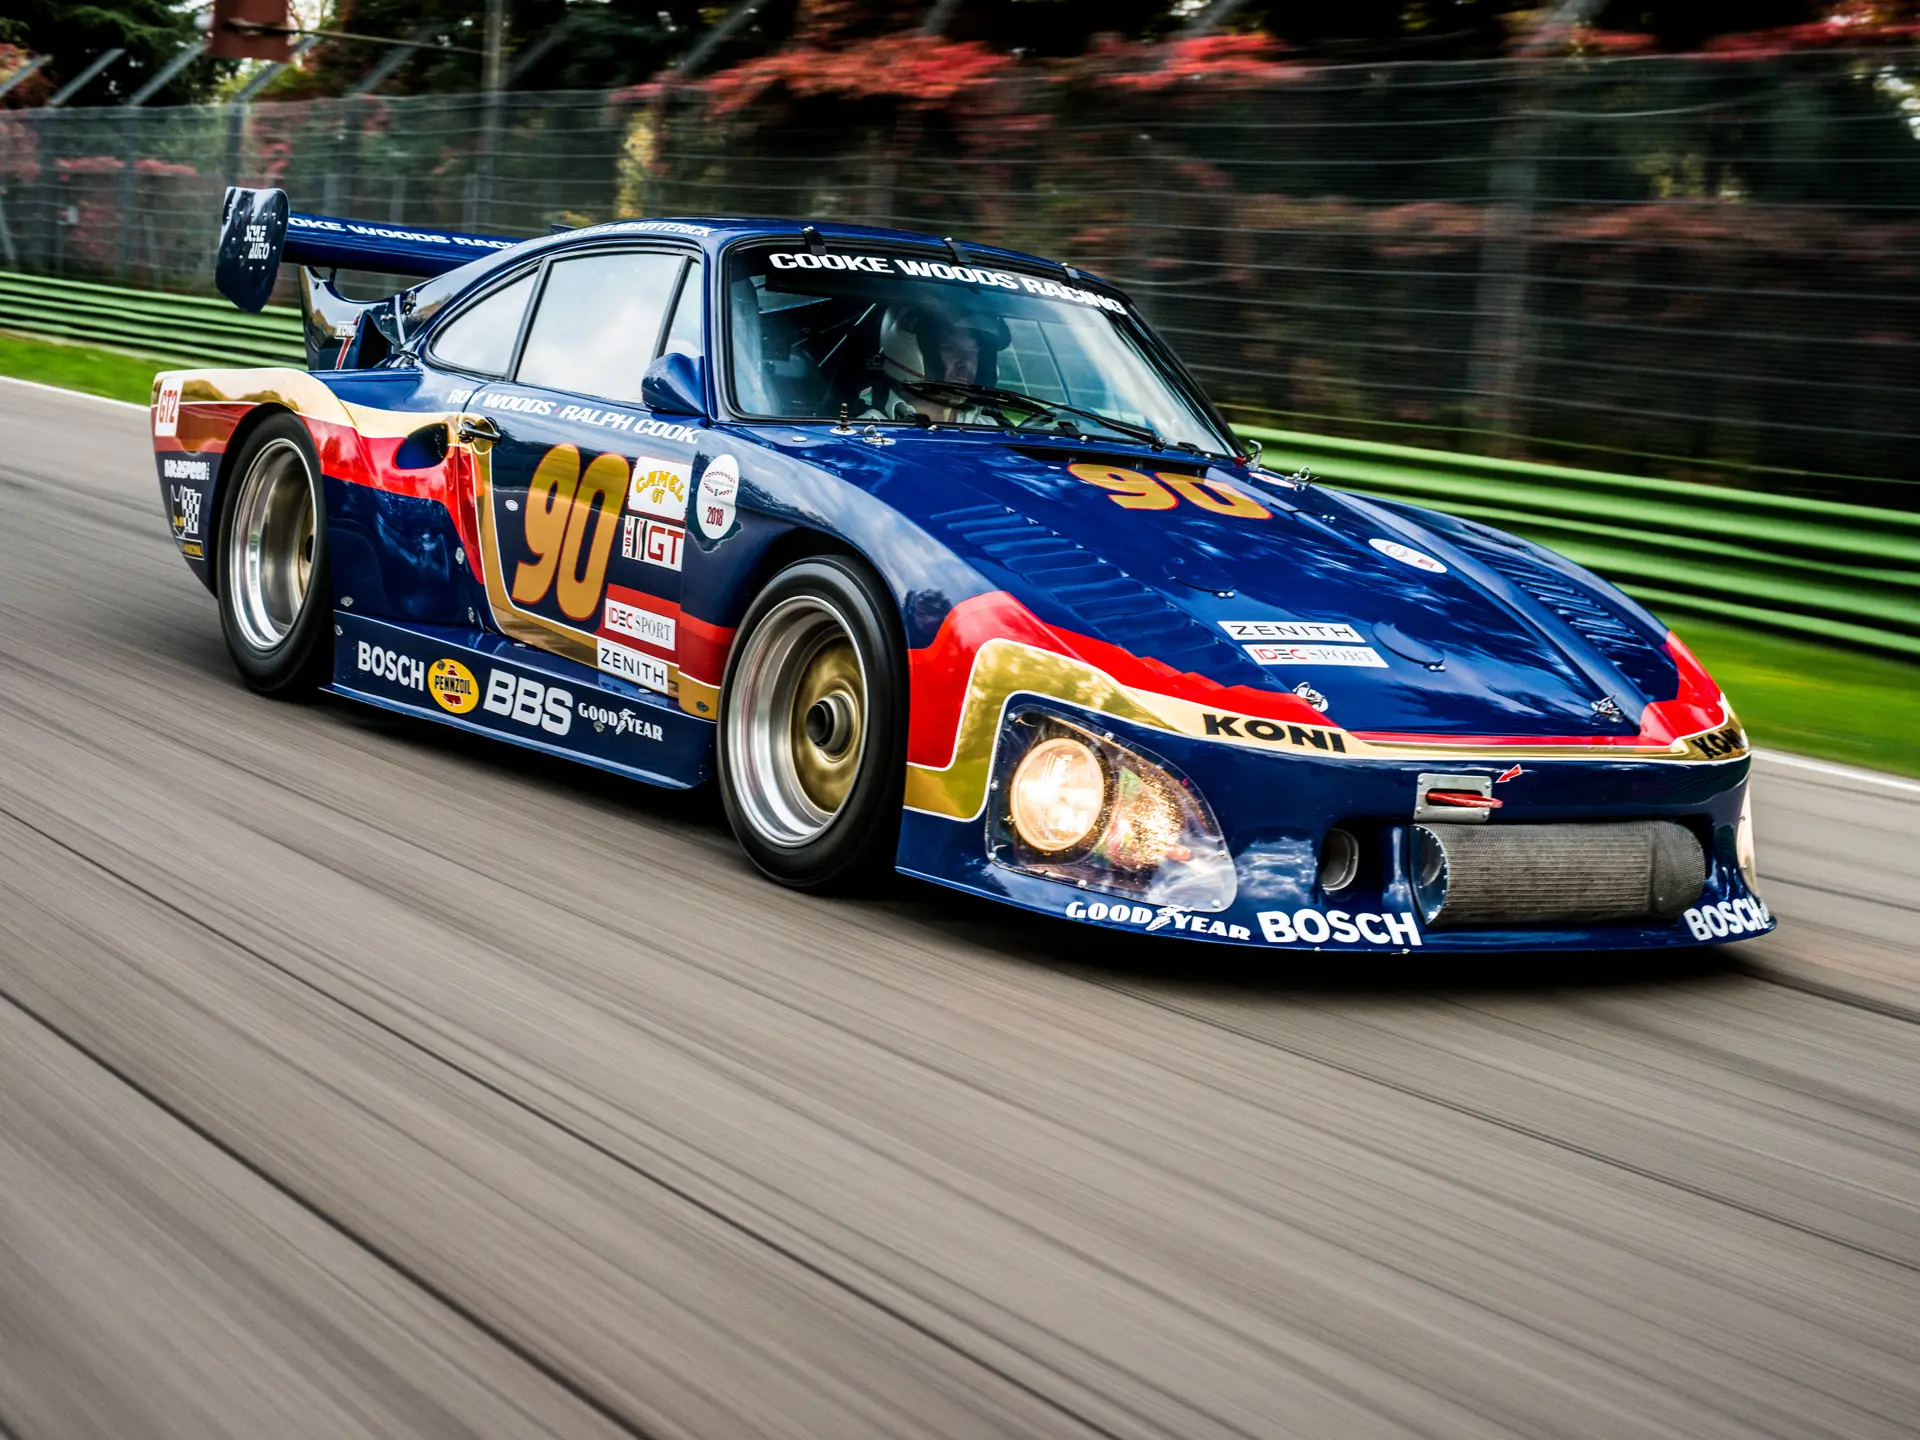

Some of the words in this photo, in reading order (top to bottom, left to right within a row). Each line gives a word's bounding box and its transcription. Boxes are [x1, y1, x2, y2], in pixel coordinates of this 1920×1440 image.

[244, 225, 267, 242] STYLE
[248, 242, 270, 260] AUTO
[287, 217, 346, 232] OKE
[347, 224, 451, 244] WOODS
[452, 237, 517, 249] RAC
[769, 253, 895, 274] COOKE
[894, 259, 1021, 290] WOODS
[1019, 276, 1129, 315] RACING
[159, 389, 178, 424] GT2
[446, 389, 486, 405] ROY
[482, 393, 557, 416] WOODS
[557, 404, 636, 431] RALPH
[635, 419, 700, 445] COOK
[635, 470, 684, 503] CAMEL
[651, 487, 665, 504] GT
[1066, 463, 1274, 520] 90
[512, 443, 630, 620] 90
[706, 506, 725, 527] 2018
[623, 516, 633, 557] IMSA
[647, 525, 685, 566] GT
[608, 606, 633, 630] IDEC
[634, 614, 672, 642] SPORT
[1230, 624, 1355, 639] ZENITH
[357, 640, 425, 691] BOSCH
[601, 647, 664, 686] ZENITH
[1253, 648, 1308, 660] IDEC
[1309, 649, 1374, 662] SPORT
[434, 674, 472, 695] PENNZOIL
[482, 668, 574, 736] BBS
[1202, 713, 1347, 754] KONI
[1690, 728, 1746, 759] KON
[1256, 909, 1423, 947] BOSCH
[1683, 897, 1769, 941] BOSCH
